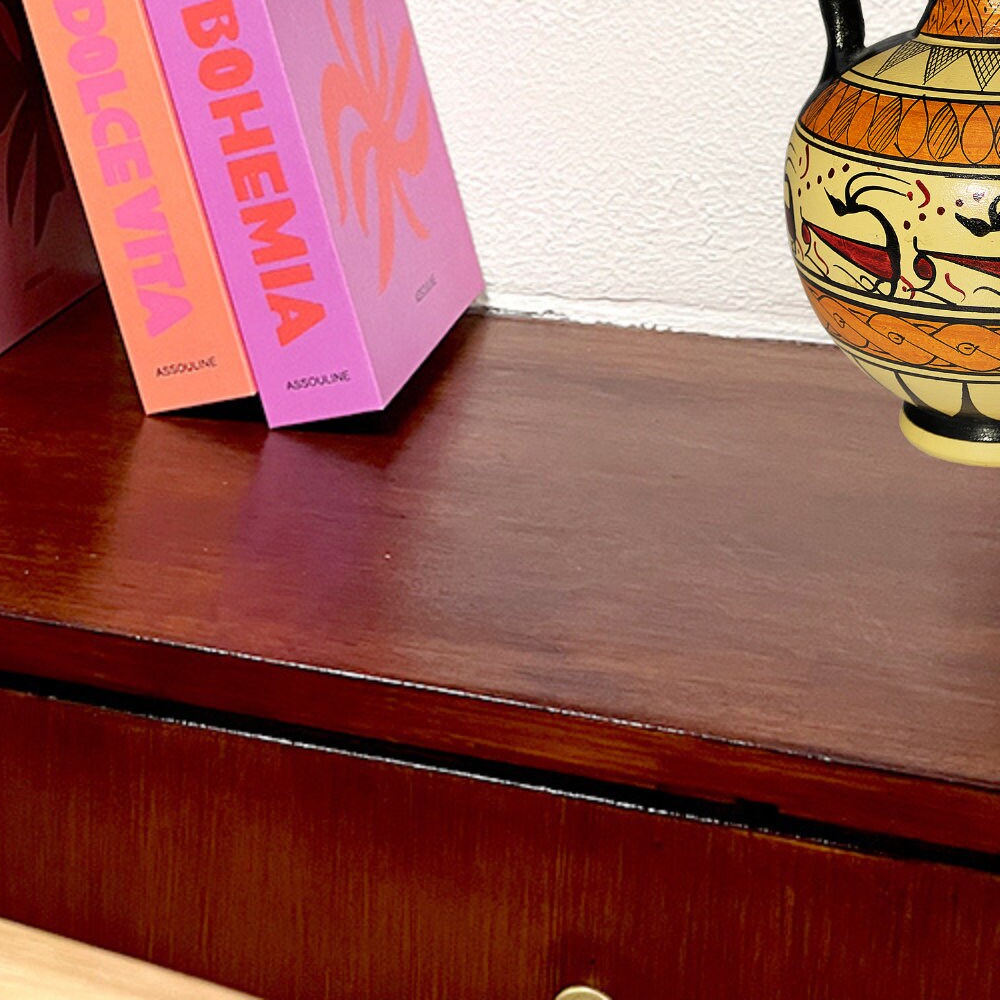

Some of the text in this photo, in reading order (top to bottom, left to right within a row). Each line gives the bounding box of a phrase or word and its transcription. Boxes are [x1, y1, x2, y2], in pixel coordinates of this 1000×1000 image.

[114, 185, 194, 338] VITA
[156, 356, 217, 377] ASSOULINE
[286, 370, 351, 391] ASSOULINE
